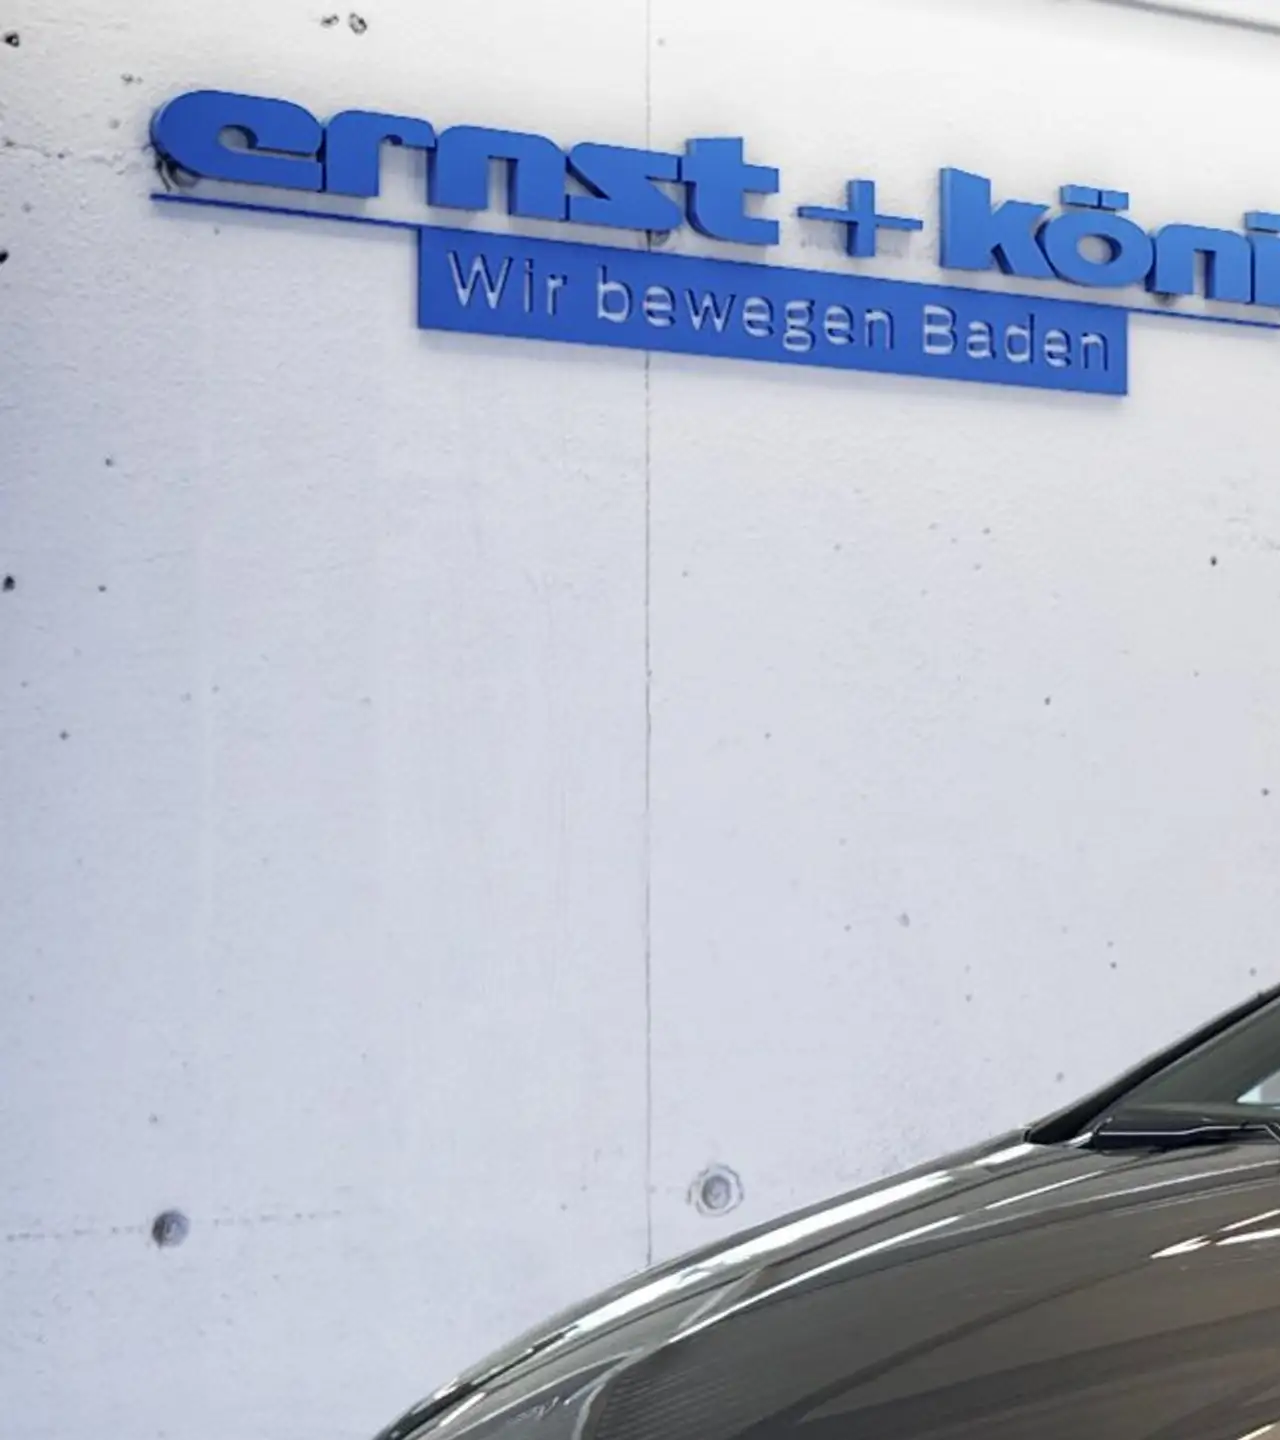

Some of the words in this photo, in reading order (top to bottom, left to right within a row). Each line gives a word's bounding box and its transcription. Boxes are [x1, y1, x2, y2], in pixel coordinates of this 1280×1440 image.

[448, 250, 568, 316] Wir
[597, 265, 895, 351] bewegen
[922, 304, 1109, 371] Baden
